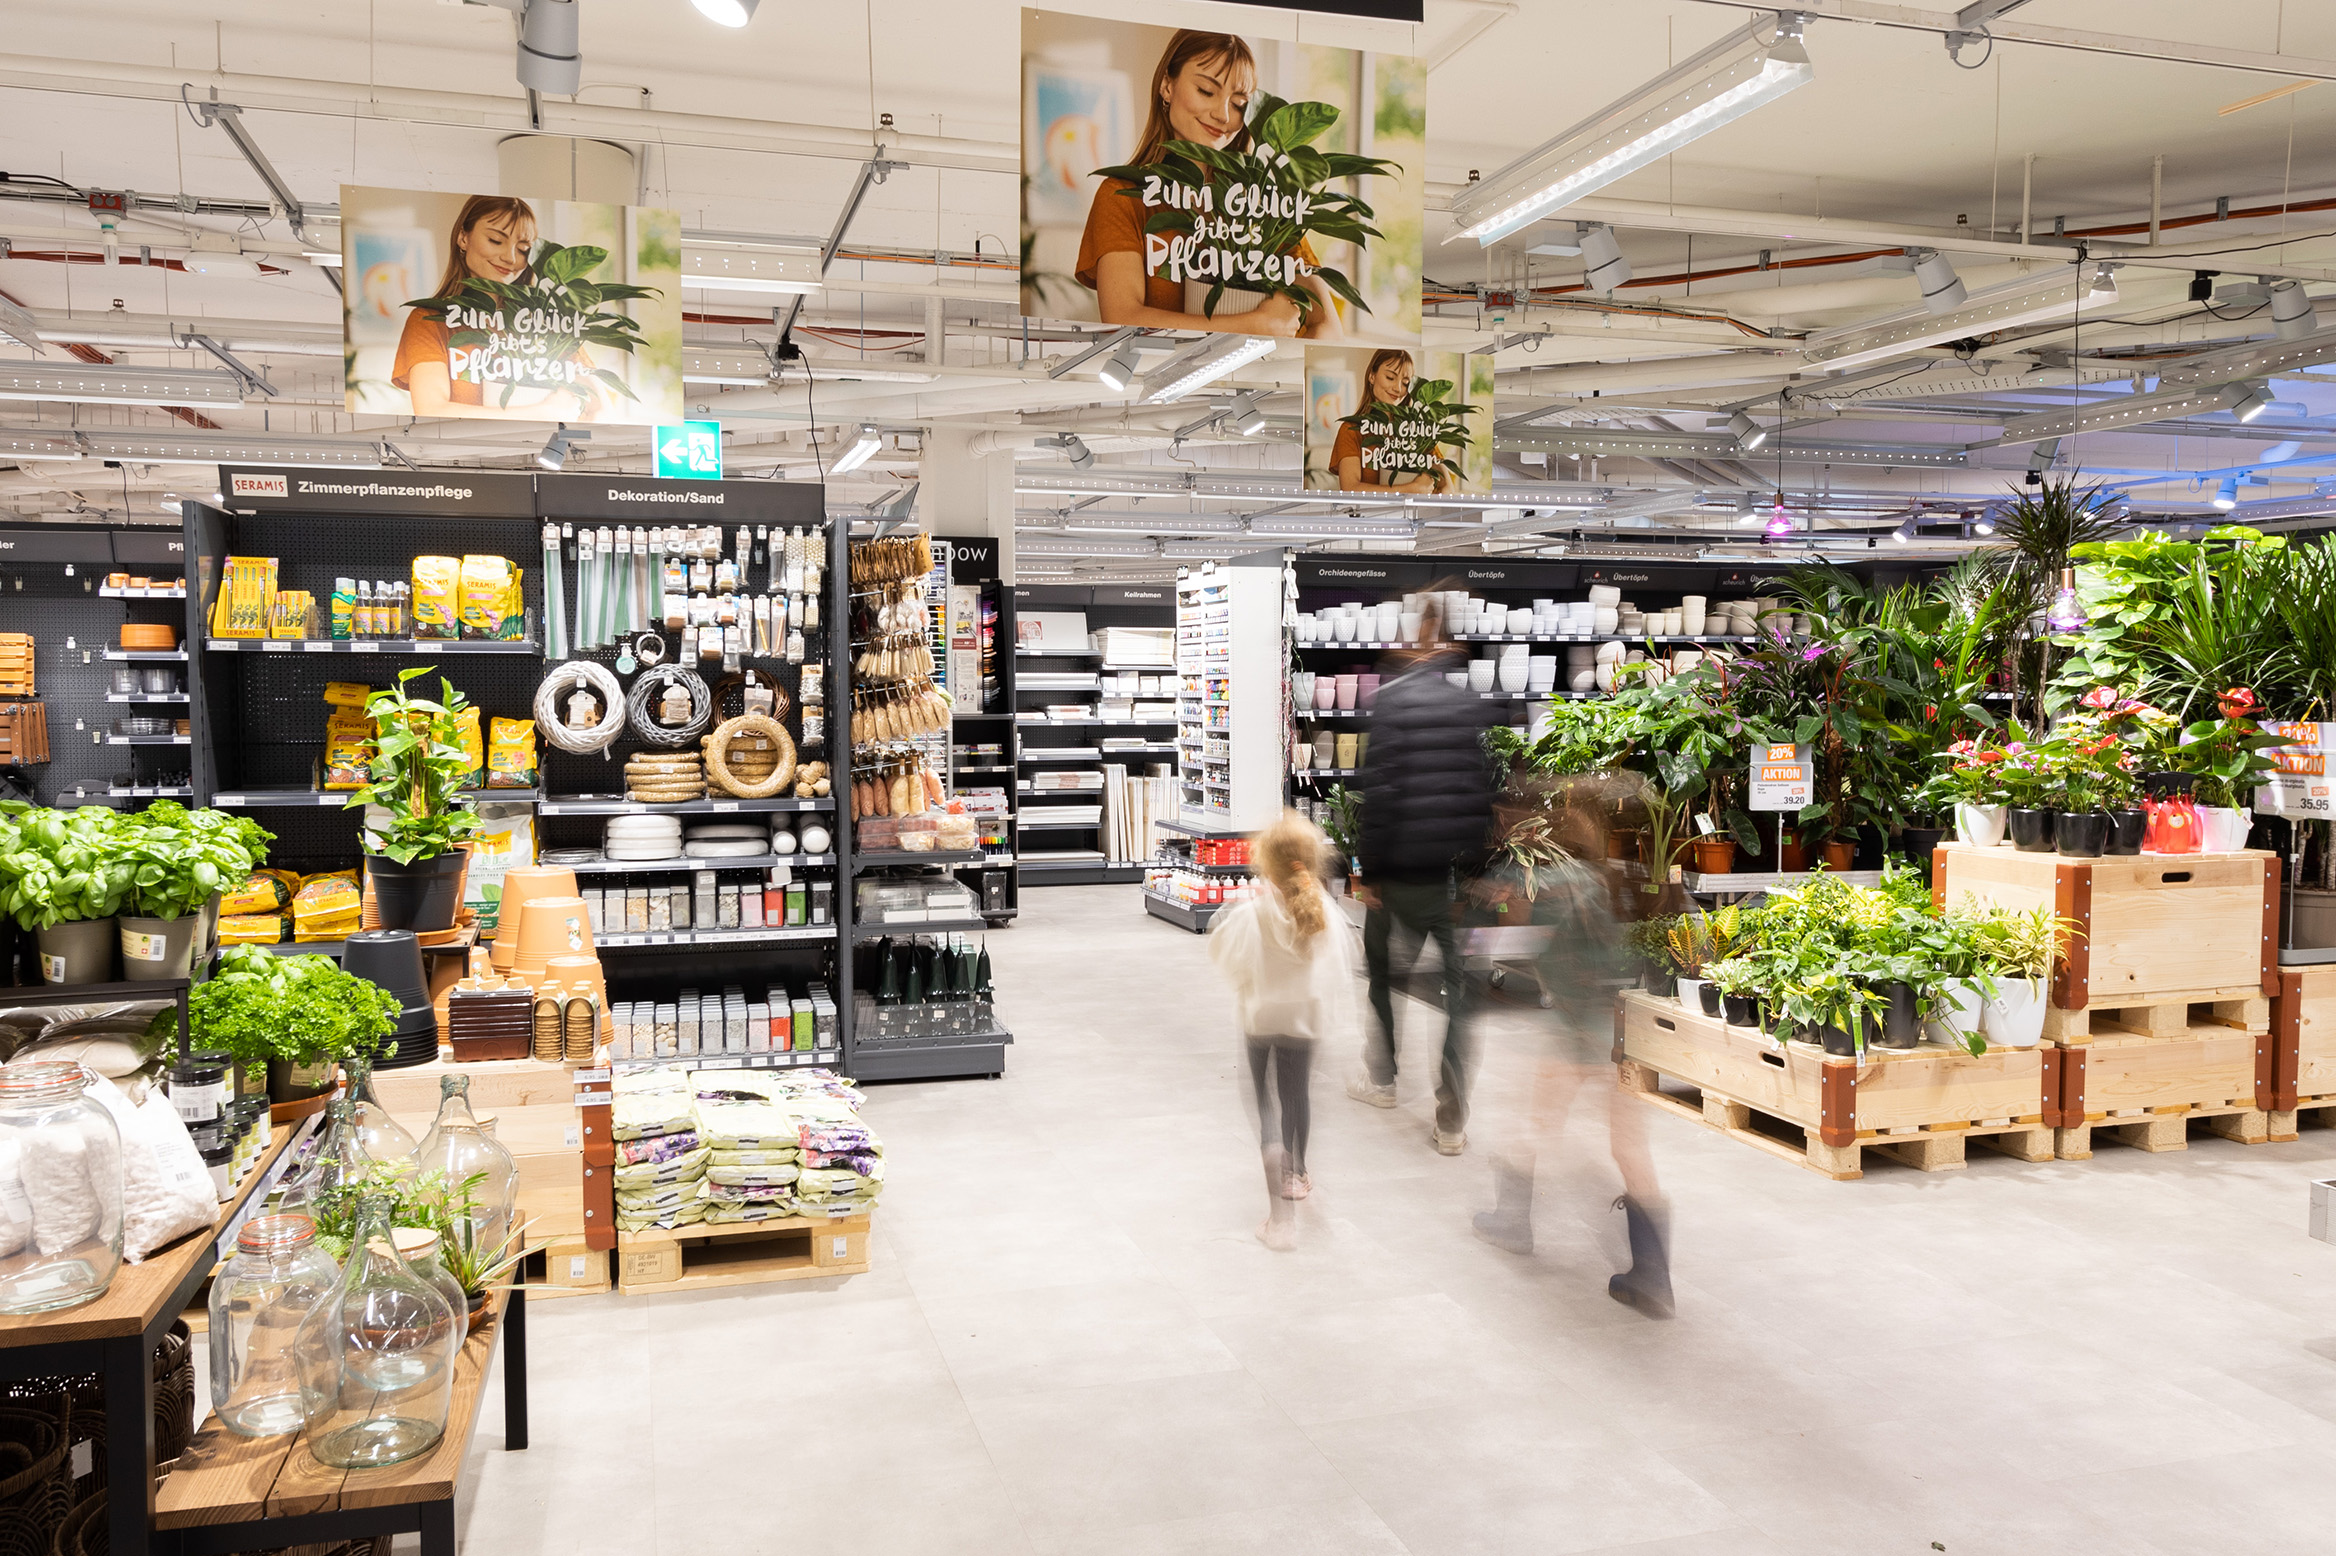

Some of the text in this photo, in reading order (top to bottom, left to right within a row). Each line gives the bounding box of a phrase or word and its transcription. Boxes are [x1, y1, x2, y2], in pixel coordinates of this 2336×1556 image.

[1142, 175, 1314, 225] Zum Glück
[1194, 214, 1263, 244] gibt's
[1145, 232, 1313, 286] Pflanzen
[445, 304, 590, 338] Zum Glück
[448, 346, 590, 384] Pflanzen
[1360, 419, 1441, 440] Zum Glück
[1361, 446, 1441, 470] Pflanzen
[234, 479, 285, 493] SERAMIS
[298, 481, 473, 499] Zimmerpflanzenpflege
[608, 489, 724, 504] Dekoration/Sand
[1319, 568, 1386, 578] Orchideengefässe
[1468, 569, 1505, 580] Übertöpfe
[1613, 572, 1649, 582] Übertöpfe
[466, 581, 497, 589] SERAMIS
[1124, 591, 1162, 599] Keilrahmen
[334, 722, 370, 730] SERAMIS
[1770, 746, 1794, 760] 20%
[2274, 755, 2323, 772] AKTION
[1762, 768, 1801, 780] AKTION
[1783, 796, 1805, 804] 39.20
[2300, 798, 2329, 810] 35.95
